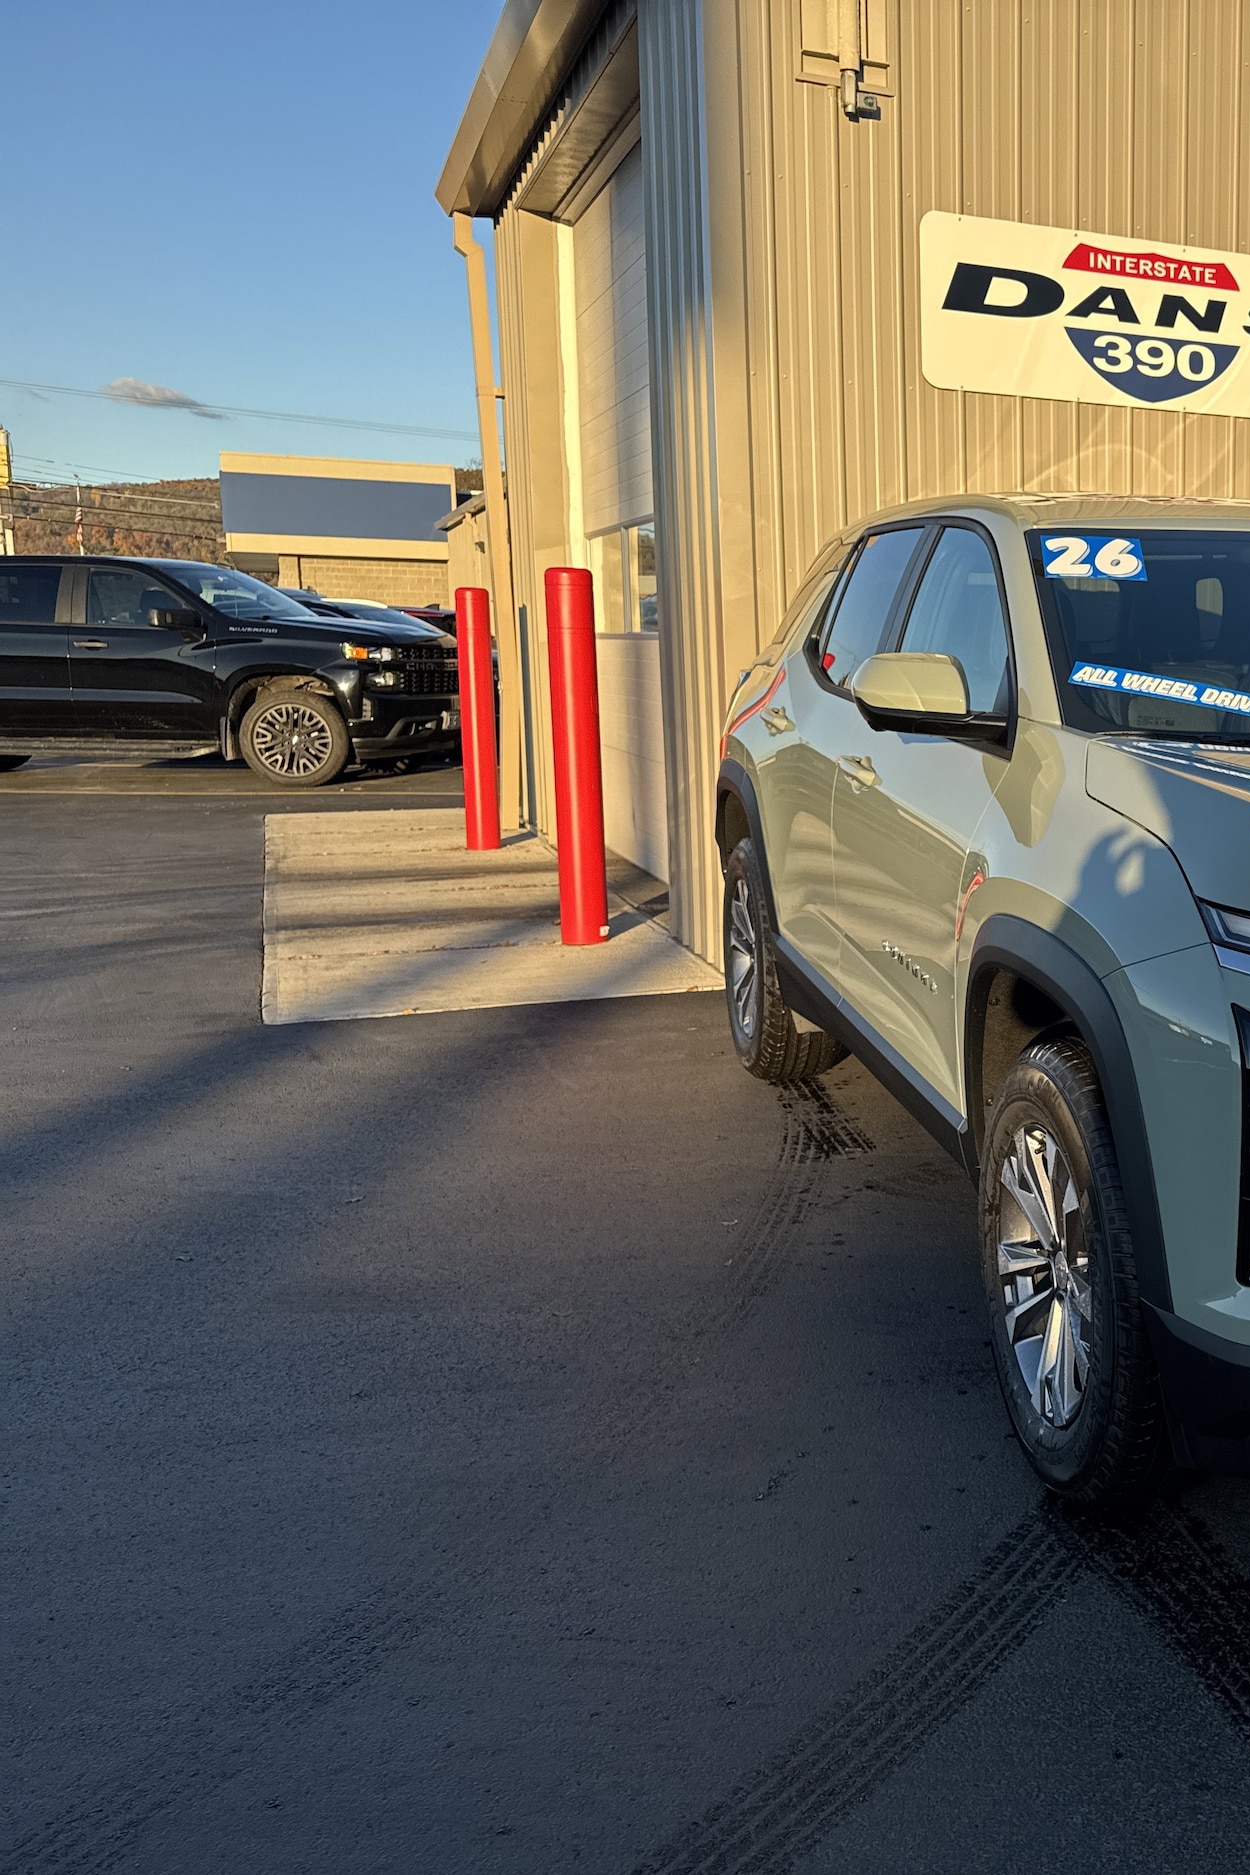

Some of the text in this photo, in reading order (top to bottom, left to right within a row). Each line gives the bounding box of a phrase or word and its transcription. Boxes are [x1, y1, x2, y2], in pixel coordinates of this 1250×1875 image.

[1088, 252, 1217, 285] INTERSTATE
[1092, 334, 1216, 382] 390
[1045, 537, 1143, 577] 26
[1072, 666, 1117, 687] ALL
[1121, 672, 1198, 702] WHEEL
